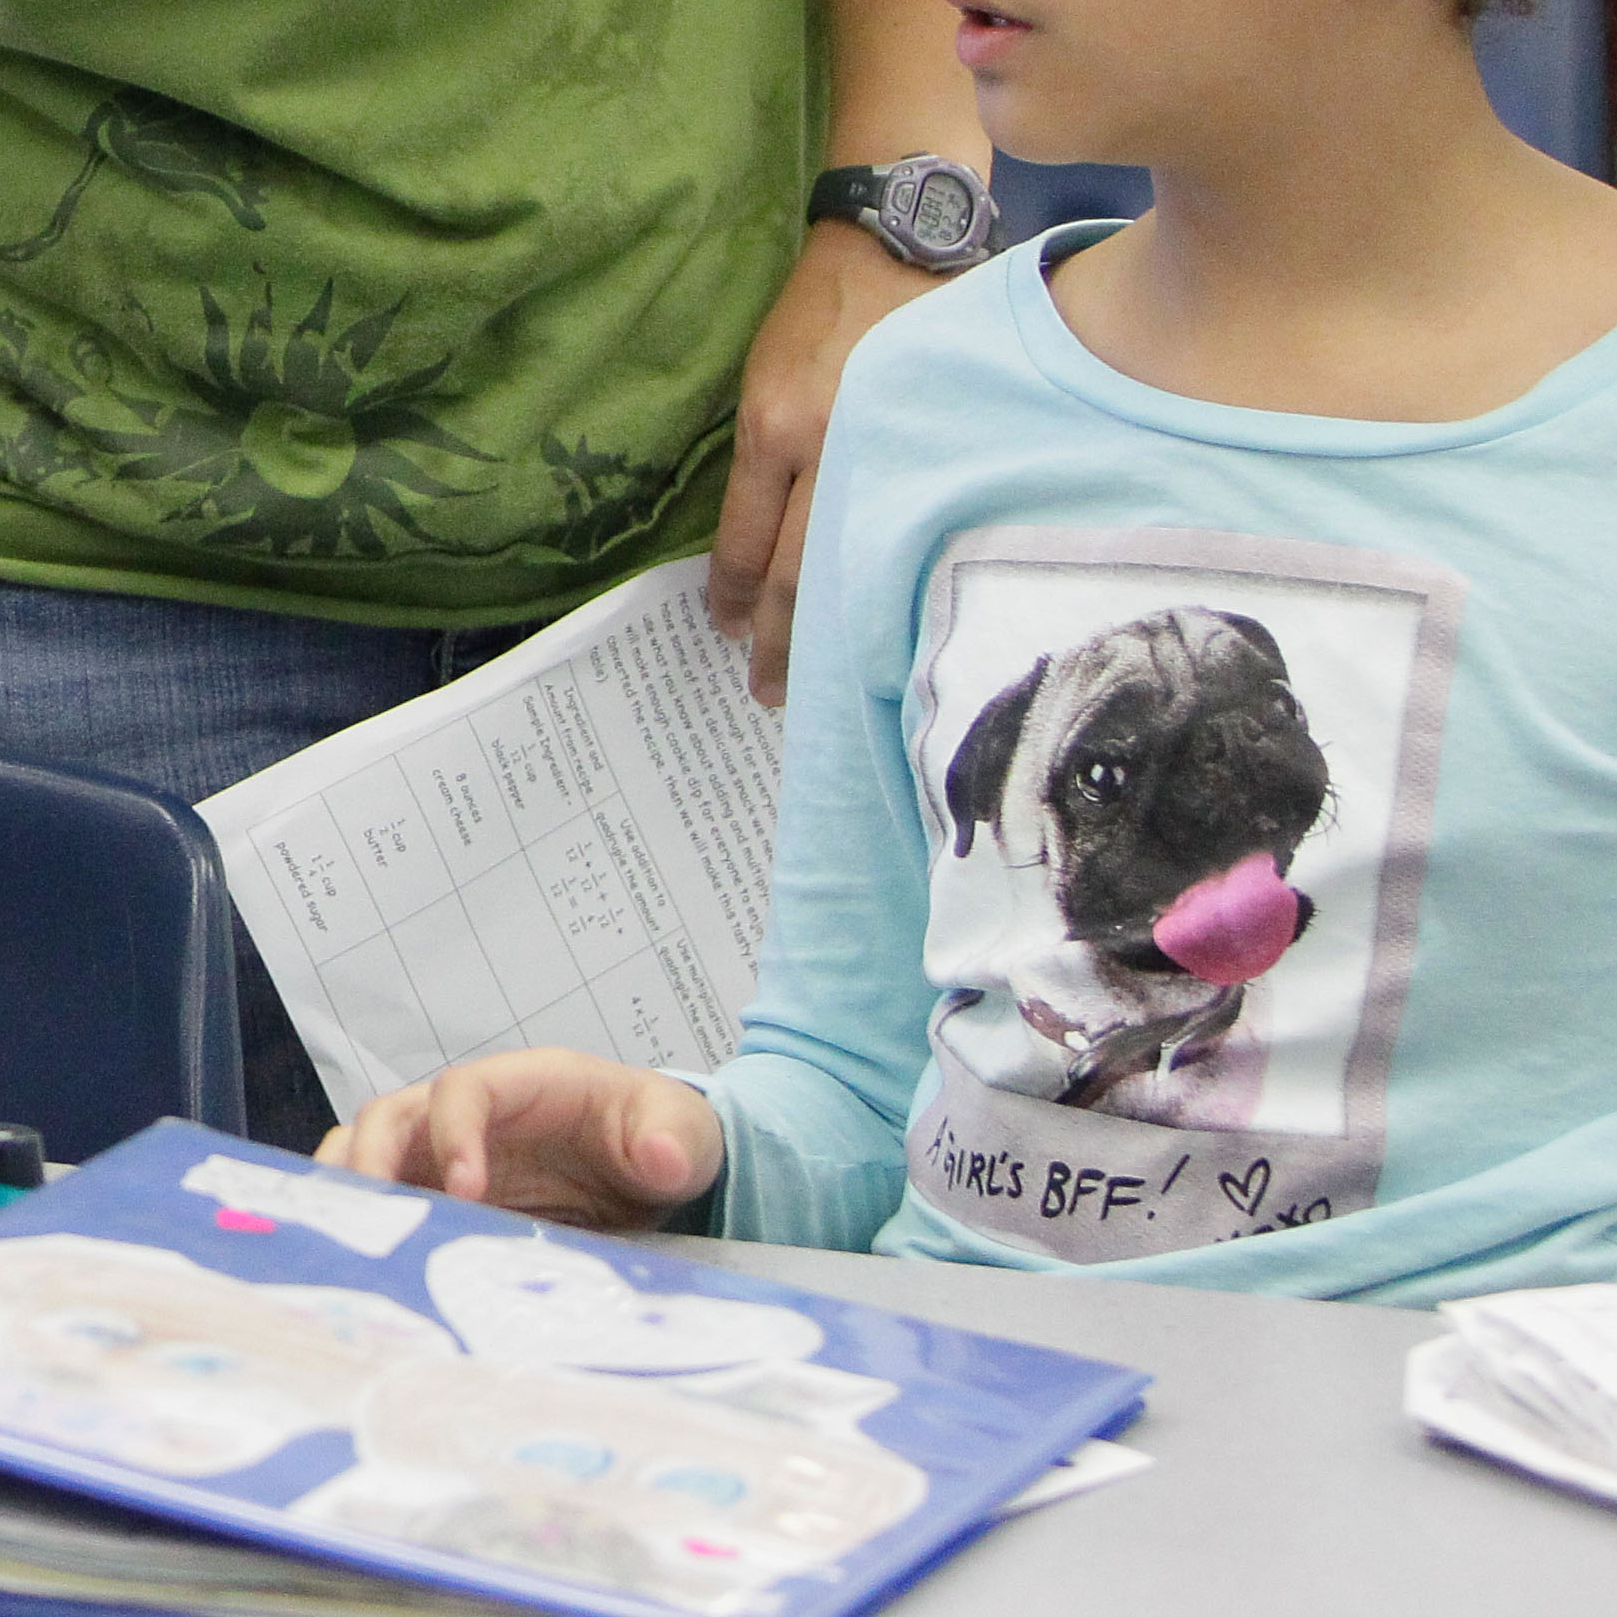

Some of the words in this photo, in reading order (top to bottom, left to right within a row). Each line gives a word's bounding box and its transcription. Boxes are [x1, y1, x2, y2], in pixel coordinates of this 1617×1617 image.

[678, 592, 697, 632] recipe
[693, 635, 703, 646] is
[699, 648, 712, 669] not
[707, 672, 722, 696] big
[718, 697, 744, 744] enough
[741, 746, 757, 767] for
[715, 631, 731, 664] with
[723, 665, 743, 694] plan
[747, 713, 781, 776] chocolate
[491, 738, 509, 771] black
[503, 772, 525, 809] pepper
[523, 696, 544, 736] Sample
[540, 736, 569, 797] Ingredient
[525, 763, 537, 783] cup
[544, 685, 566, 724] Amount
[562, 728, 578, 757] from
[570, 759, 593, 795] recipe
[564, 686, 596, 747] Ingredient
[589, 750, 604, 771] and
[625, 624, 639, 644] will
[633, 647, 649, 680] make
[645, 683, 671, 729] enough
[666, 732, 691, 775] cookie
[688, 778, 702, 798] dip
[698, 801, 715, 822] for
[711, 827, 743, 886] everyone
[741, 888, 749, 903] to
[643, 614, 655, 635] use
[650, 637, 668, 667] what
[660, 671, 677, 695] you
[674, 695, 693, 729] know
[689, 733, 714, 770] about
[708, 774, 734, 819] adding
[730, 820, 749, 845] and
[670, 634, 688, 667] some
[684, 670, 699, 684] of
[693, 688, 710, 715] this
[706, 718, 738, 776] delicious
[733, 778, 756, 816] snack
[752, 818, 765, 836] we
[392, 833, 406, 852] cup
[433, 769, 453, 805] cream
[450, 807, 472, 846] cheese
[461, 785, 482, 824] ounces
[606, 635, 638, 698] converted
[632, 700, 645, 724] the
[664, 775, 683, 808] then
[680, 810, 693, 828] we
[690, 831, 708, 853] will
[701, 856, 722, 891] make
[719, 893, 736, 920] this
[732, 922, 752, 957] tasty
[274, 842, 313, 898] powdered
[307, 901, 328, 931] sugar
[322, 877, 336, 897] cup
[364, 828, 387, 867] butter
[596, 812, 627, 867] quadruple
[625, 869, 638, 890] the
[635, 892, 660, 931] amount
[620, 819, 635, 843] Use
[631, 845, 658, 892] addition
[657, 894, 665, 906] to
[659, 947, 689, 1002] quadruple
[688, 1003, 700, 1024] the
[696, 1026, 721, 1066] amount
[677, 938, 691, 963] Use
[688, 964, 726, 1040] multiplication
[726, 1042, 733, 1055] to
[1041, 1153, 1190, 1221] BFF!
